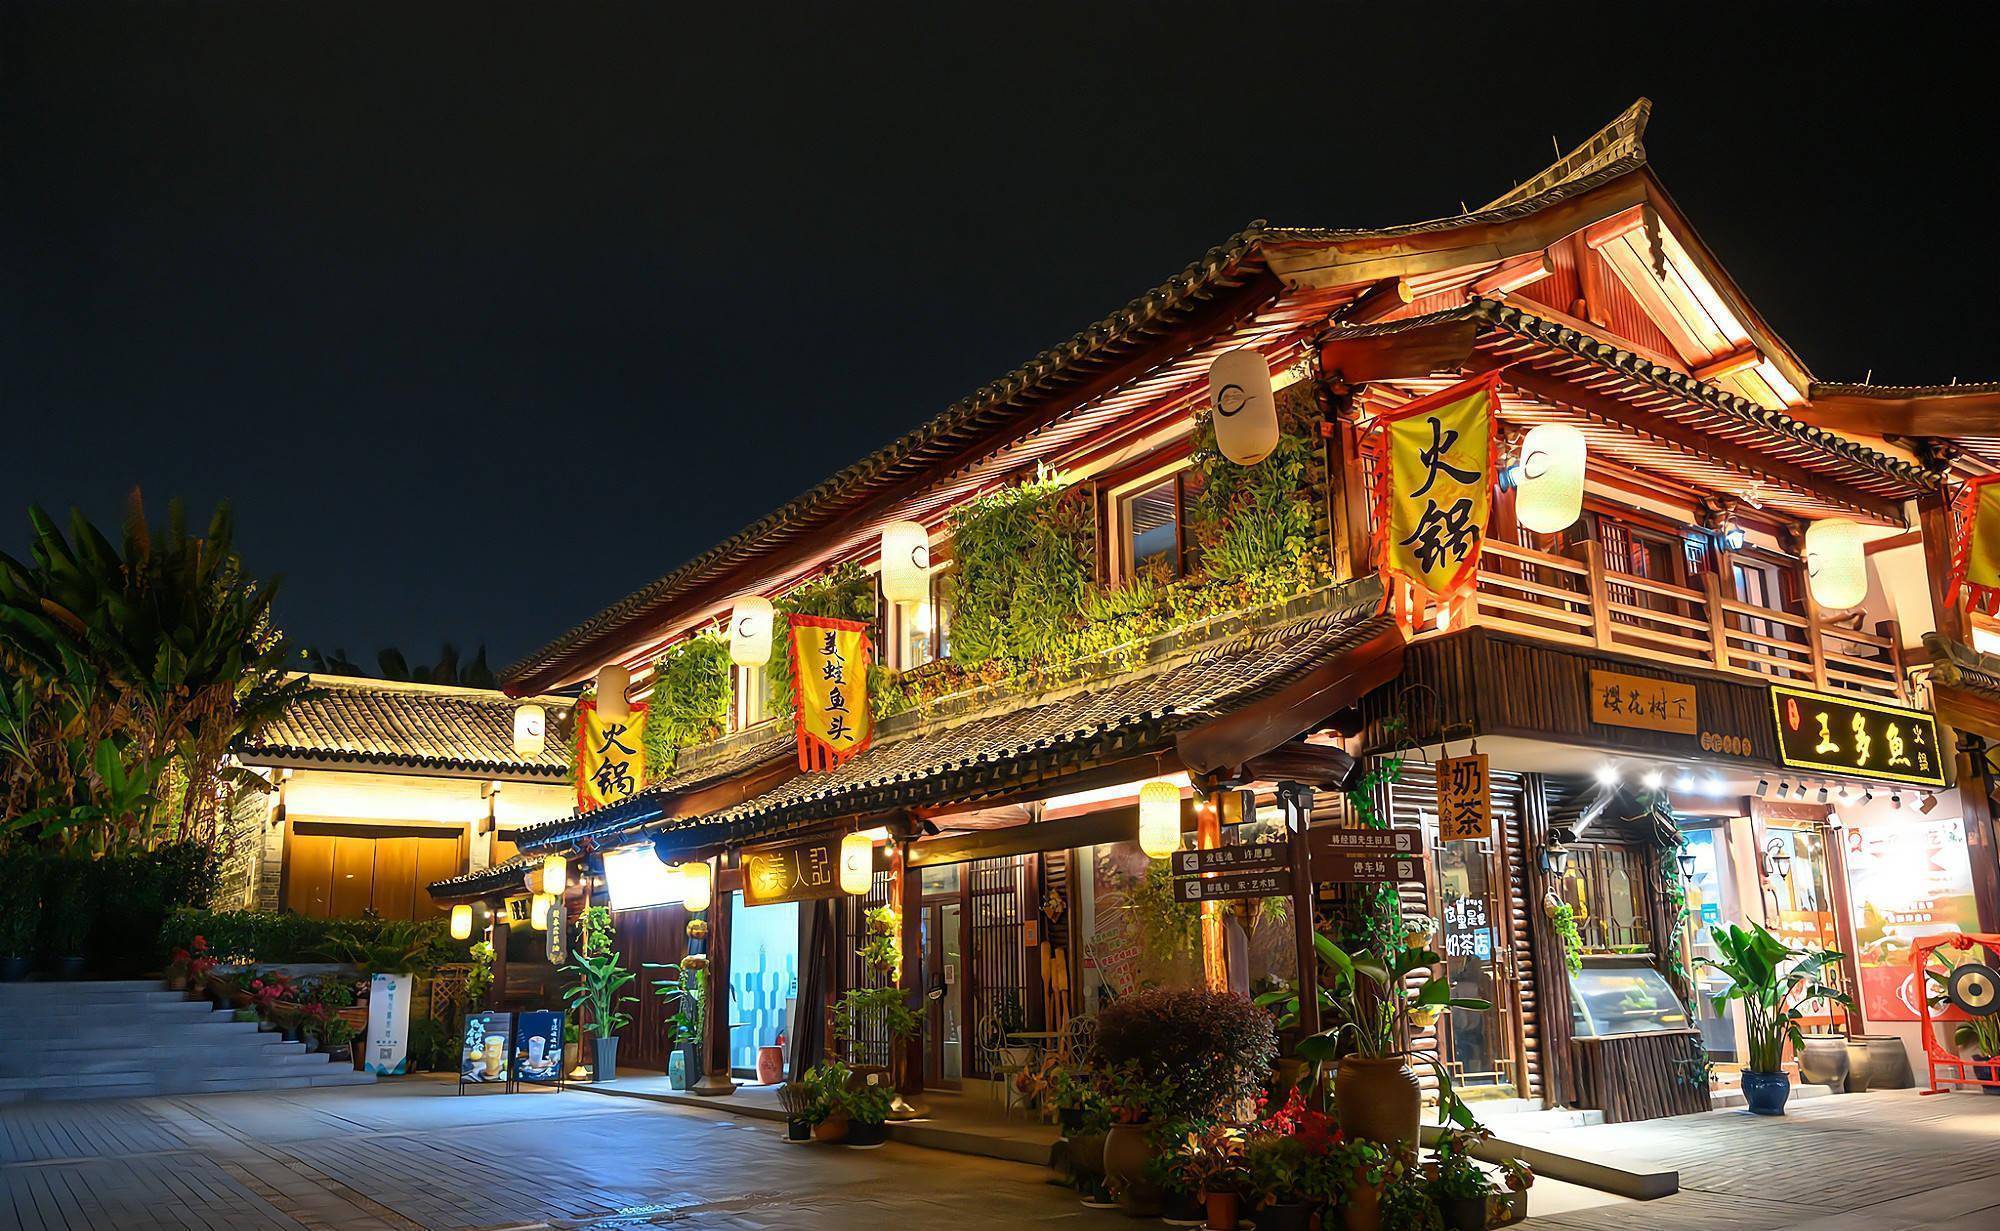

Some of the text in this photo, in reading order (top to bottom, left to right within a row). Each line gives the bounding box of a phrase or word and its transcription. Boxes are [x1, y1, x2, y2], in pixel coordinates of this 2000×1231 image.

[1398, 415, 1482, 575] 火锅
[817, 630, 855, 743] 美蛙鱼头
[589, 722, 637, 796] 火锅
[1452, 761, 1483, 835] 奶茶
[1353, 861, 1386, 874] 停车场
[1445, 933, 1489, 957] 奶茶店
